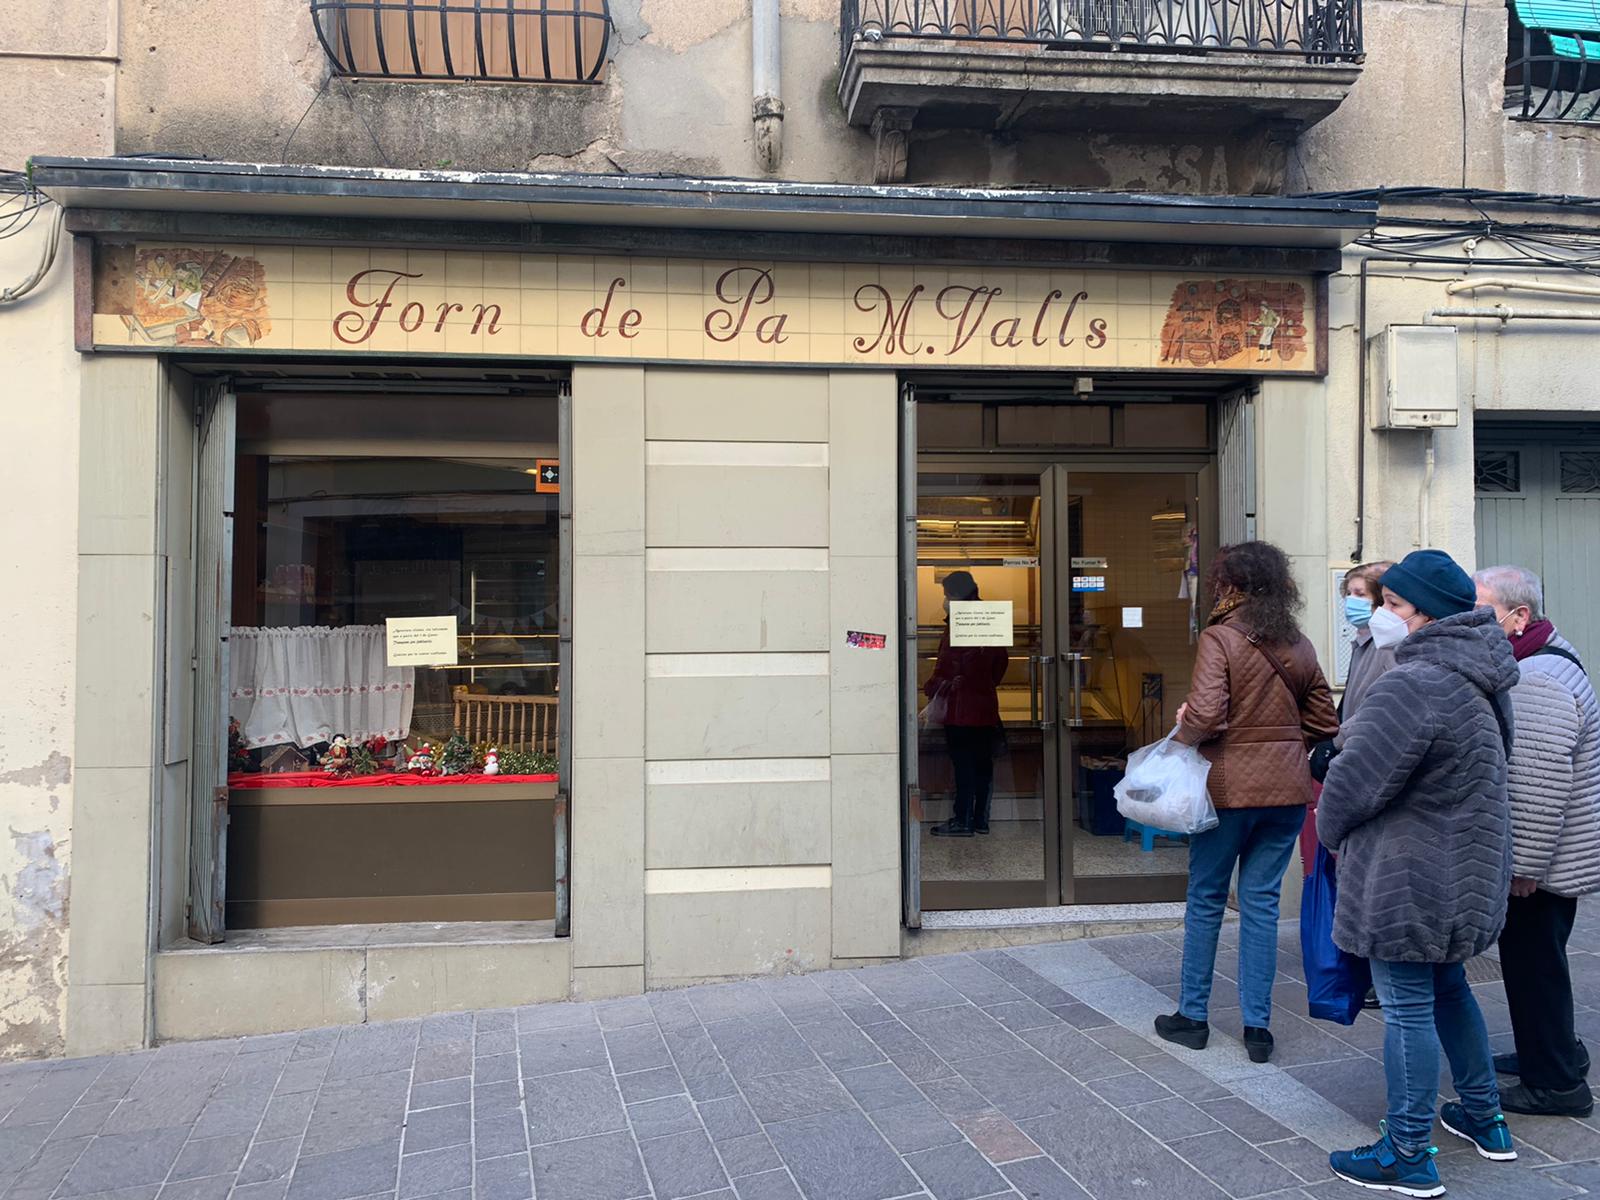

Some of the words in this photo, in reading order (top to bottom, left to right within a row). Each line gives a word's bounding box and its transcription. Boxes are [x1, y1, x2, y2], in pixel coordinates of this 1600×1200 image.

[332, 268, 502, 345] Forn
[580, 277, 643, 339] de
[704, 266, 789, 344] Pa
